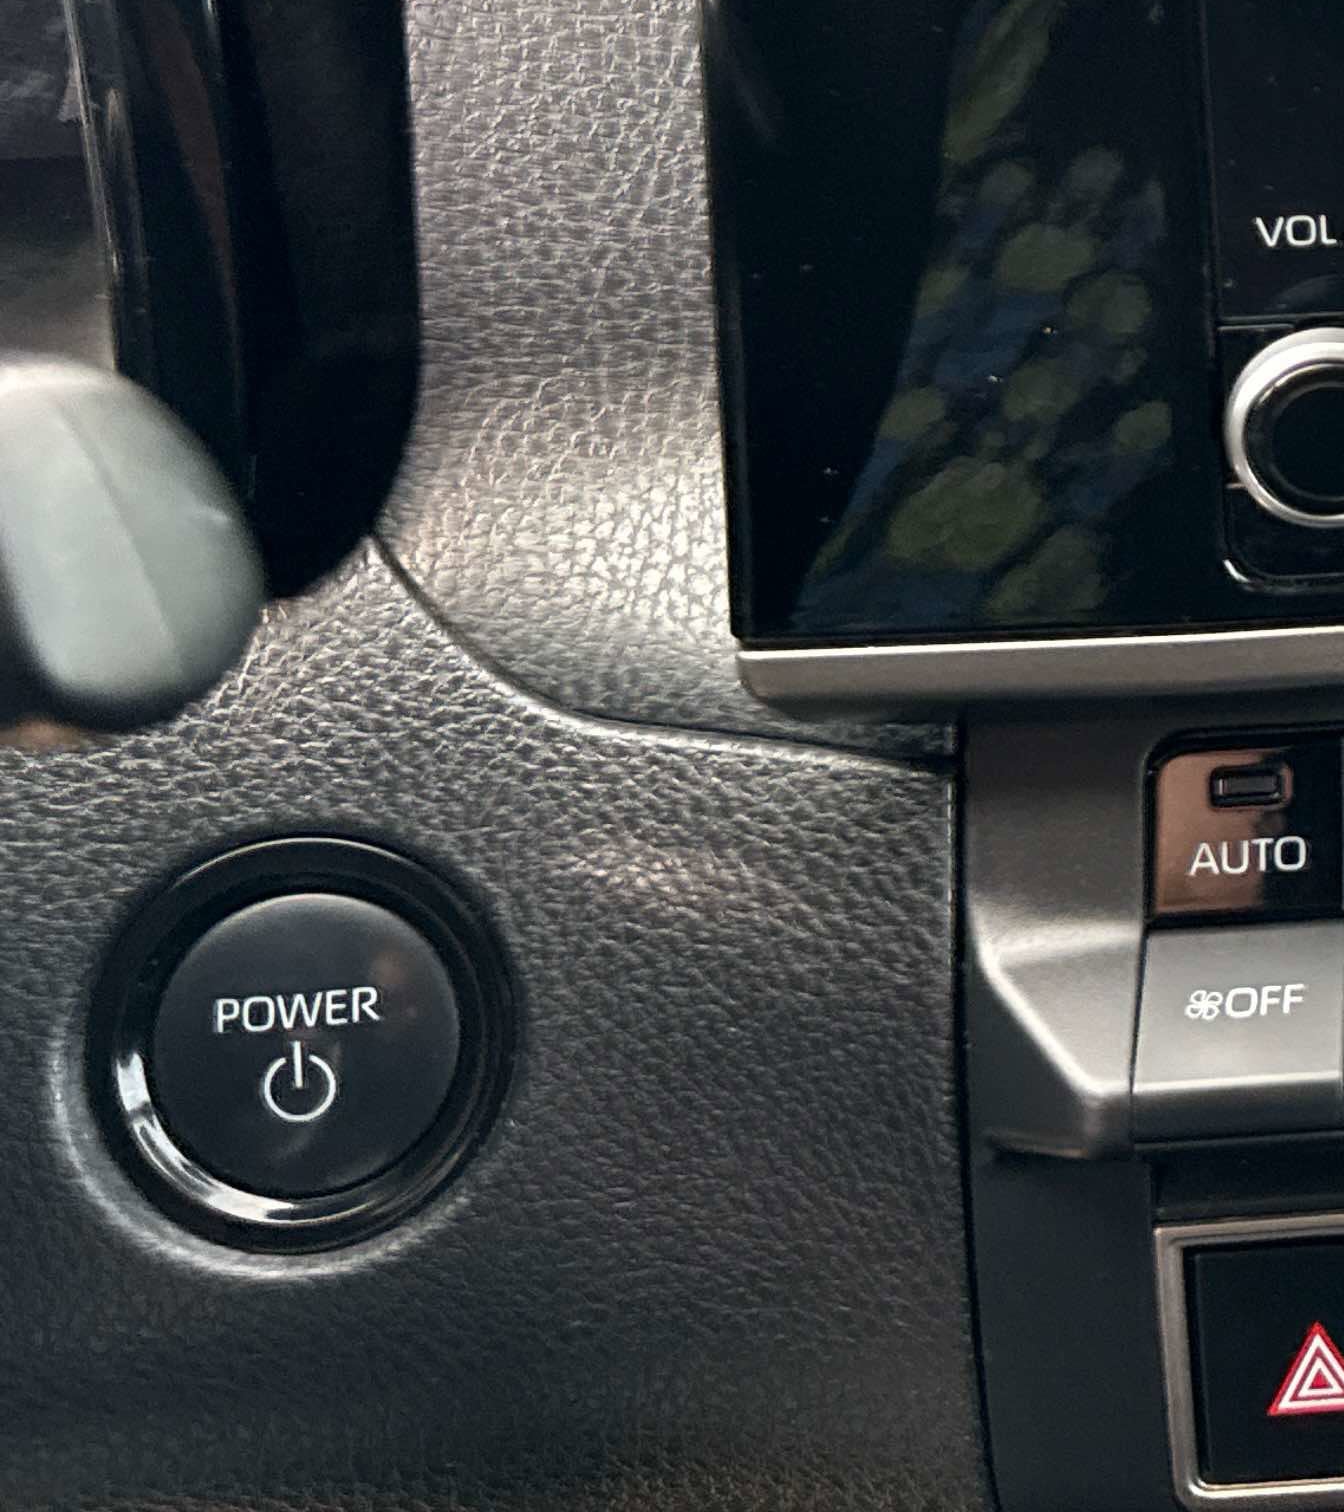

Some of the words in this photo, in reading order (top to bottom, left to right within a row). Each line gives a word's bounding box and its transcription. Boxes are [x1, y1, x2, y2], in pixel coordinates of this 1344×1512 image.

[1255, 215, 1337, 247] VOL
[1189, 835, 1308, 876] AUTO
[217, 987, 380, 1032] POWER
[1225, 984, 1305, 1018] OFF
